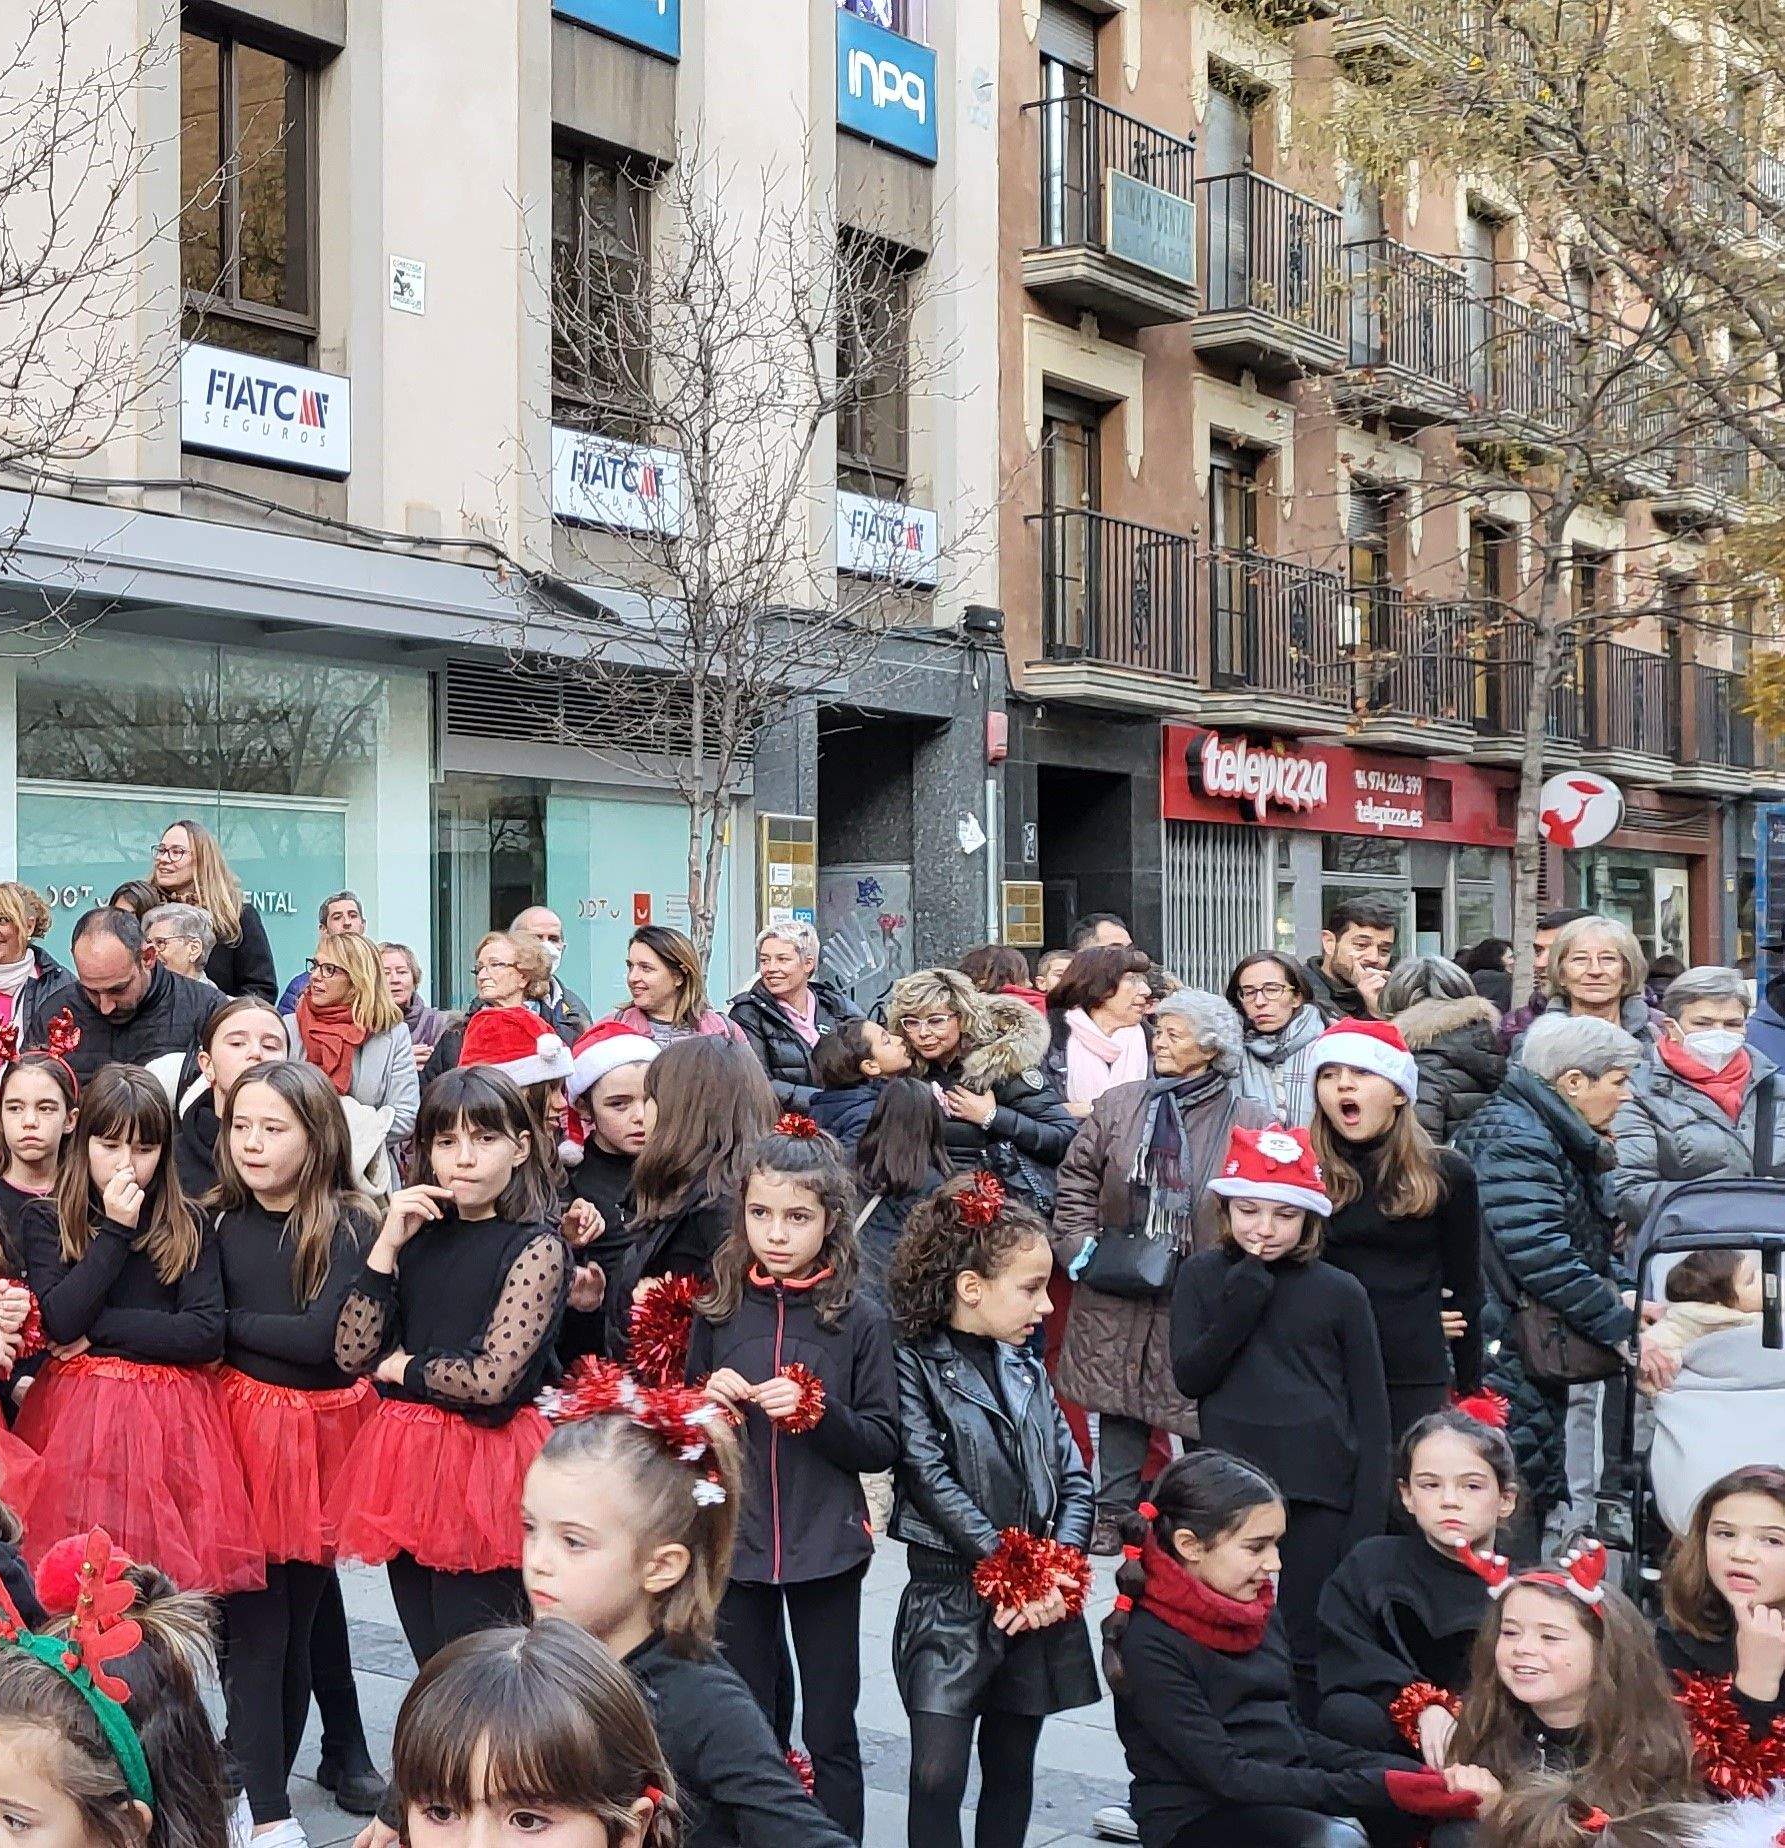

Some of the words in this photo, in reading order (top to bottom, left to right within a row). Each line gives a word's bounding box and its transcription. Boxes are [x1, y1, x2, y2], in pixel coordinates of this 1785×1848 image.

[206, 368, 297, 421] FIATC
[204, 411, 326, 447] SEGUROS
[1203, 731, 1328, 820] telepizza
[1368, 770, 1385, 791] 974
[242, 890, 298, 913] ENTAL
